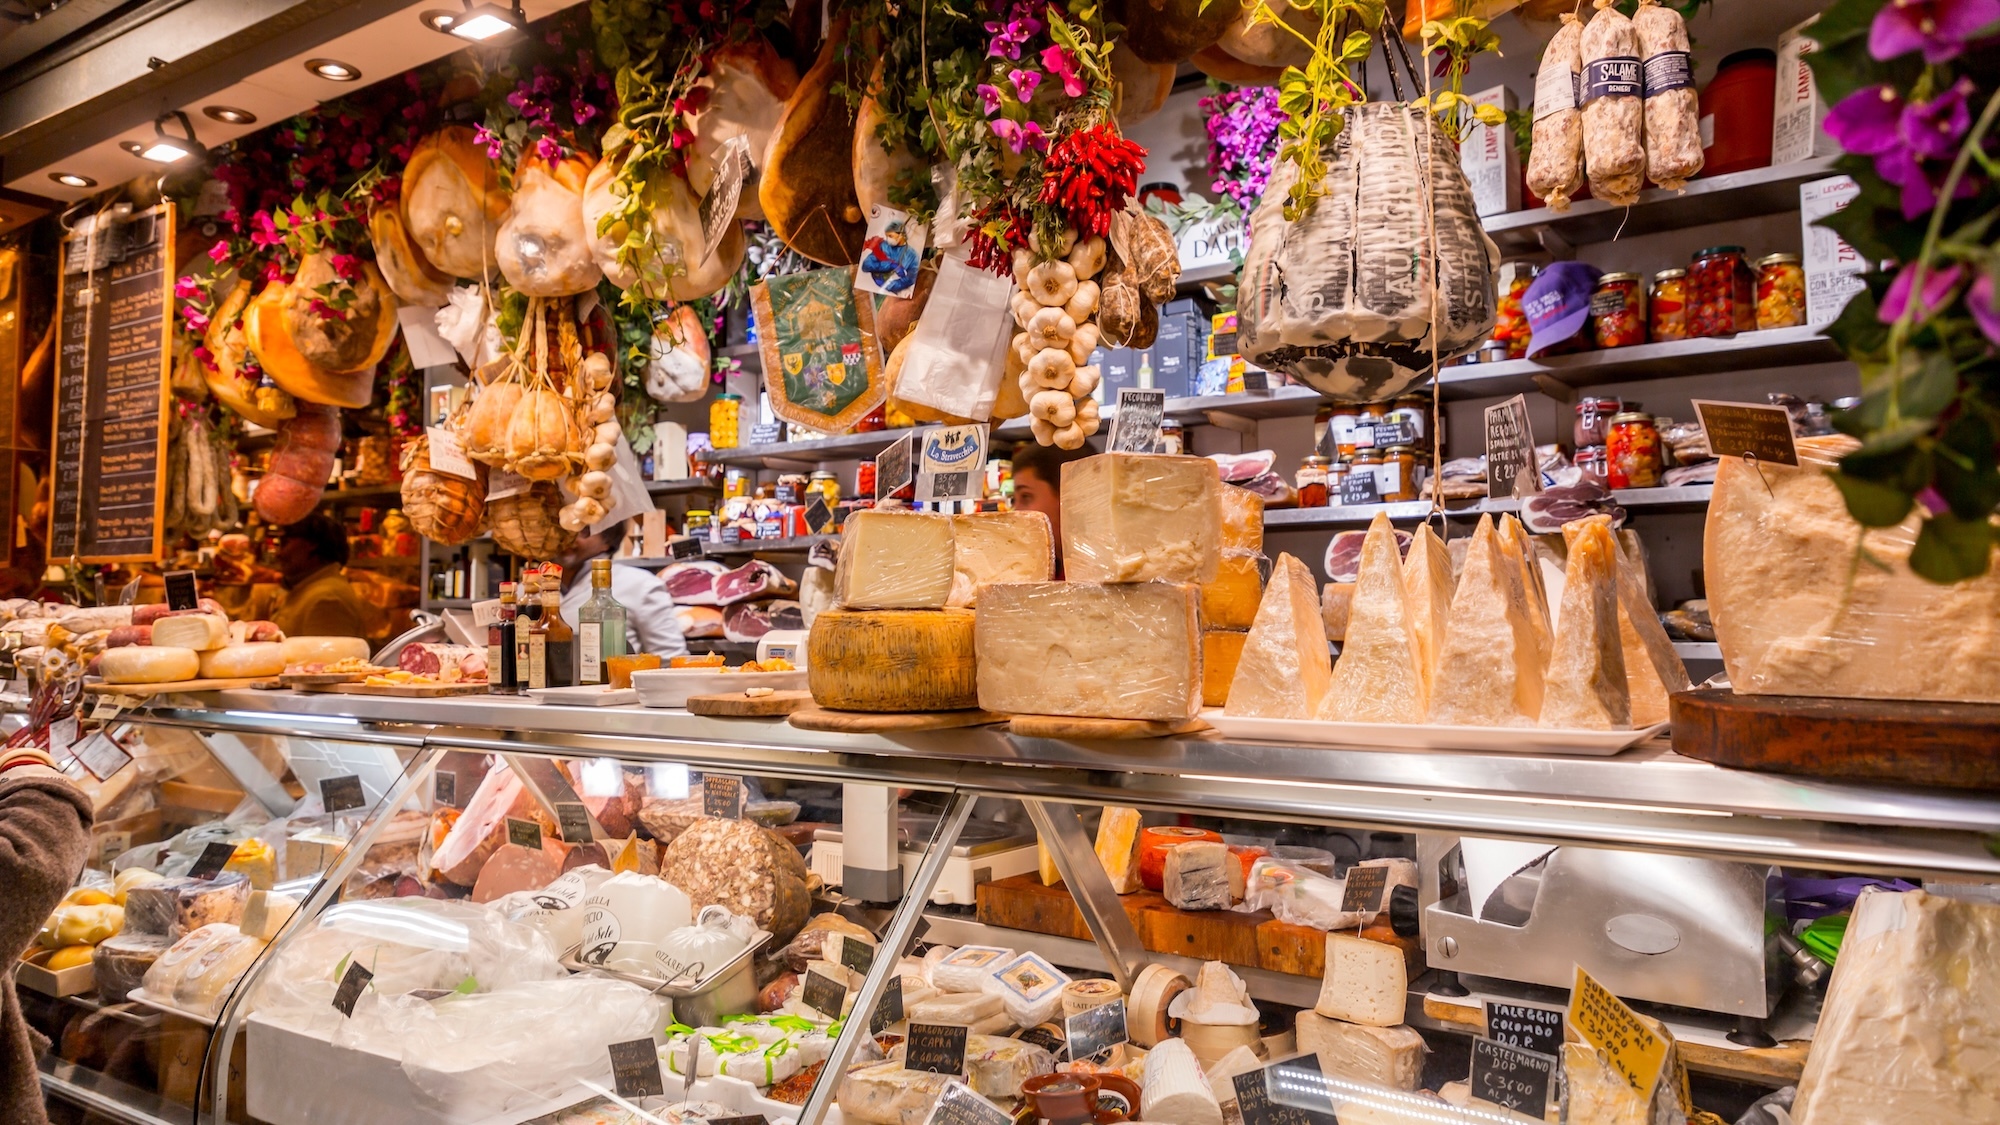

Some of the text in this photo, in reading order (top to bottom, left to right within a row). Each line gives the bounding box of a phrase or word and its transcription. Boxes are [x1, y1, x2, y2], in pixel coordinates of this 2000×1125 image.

[1601, 64, 1637, 81] SALAME
[1194, 233, 1245, 259] DAU
[1810, 279, 1827, 291] CON
[930, 445, 974, 462] Lo Stravecchio
[1495, 465, 1502, 482] €
[584, 896, 611, 908] ARELLA
[595, 924, 614, 941] Sele
[1493, 1004, 1559, 1025] TALEGGIO
[1584, 975, 1654, 1047] GORGONZOLA
[1584, 988, 1645, 1051] CREMOSO AL
[912, 1024, 966, 1037] GORGONZOLA
[1491, 1018, 1553, 1037] COLOMBO
[1581, 996, 1628, 1050] TARTUFO
[921, 1036, 952, 1049] CAPRA
[1478, 1043, 1549, 1073] CASTELMAGNO
[1492, 1058, 1517, 1073] DOP
[1616, 1059, 1625, 1074] AL
[1484, 1072, 1492, 1087] €
[1240, 1087, 1268, 1103] BARRI
[1488, 1088, 1500, 1100] AL
